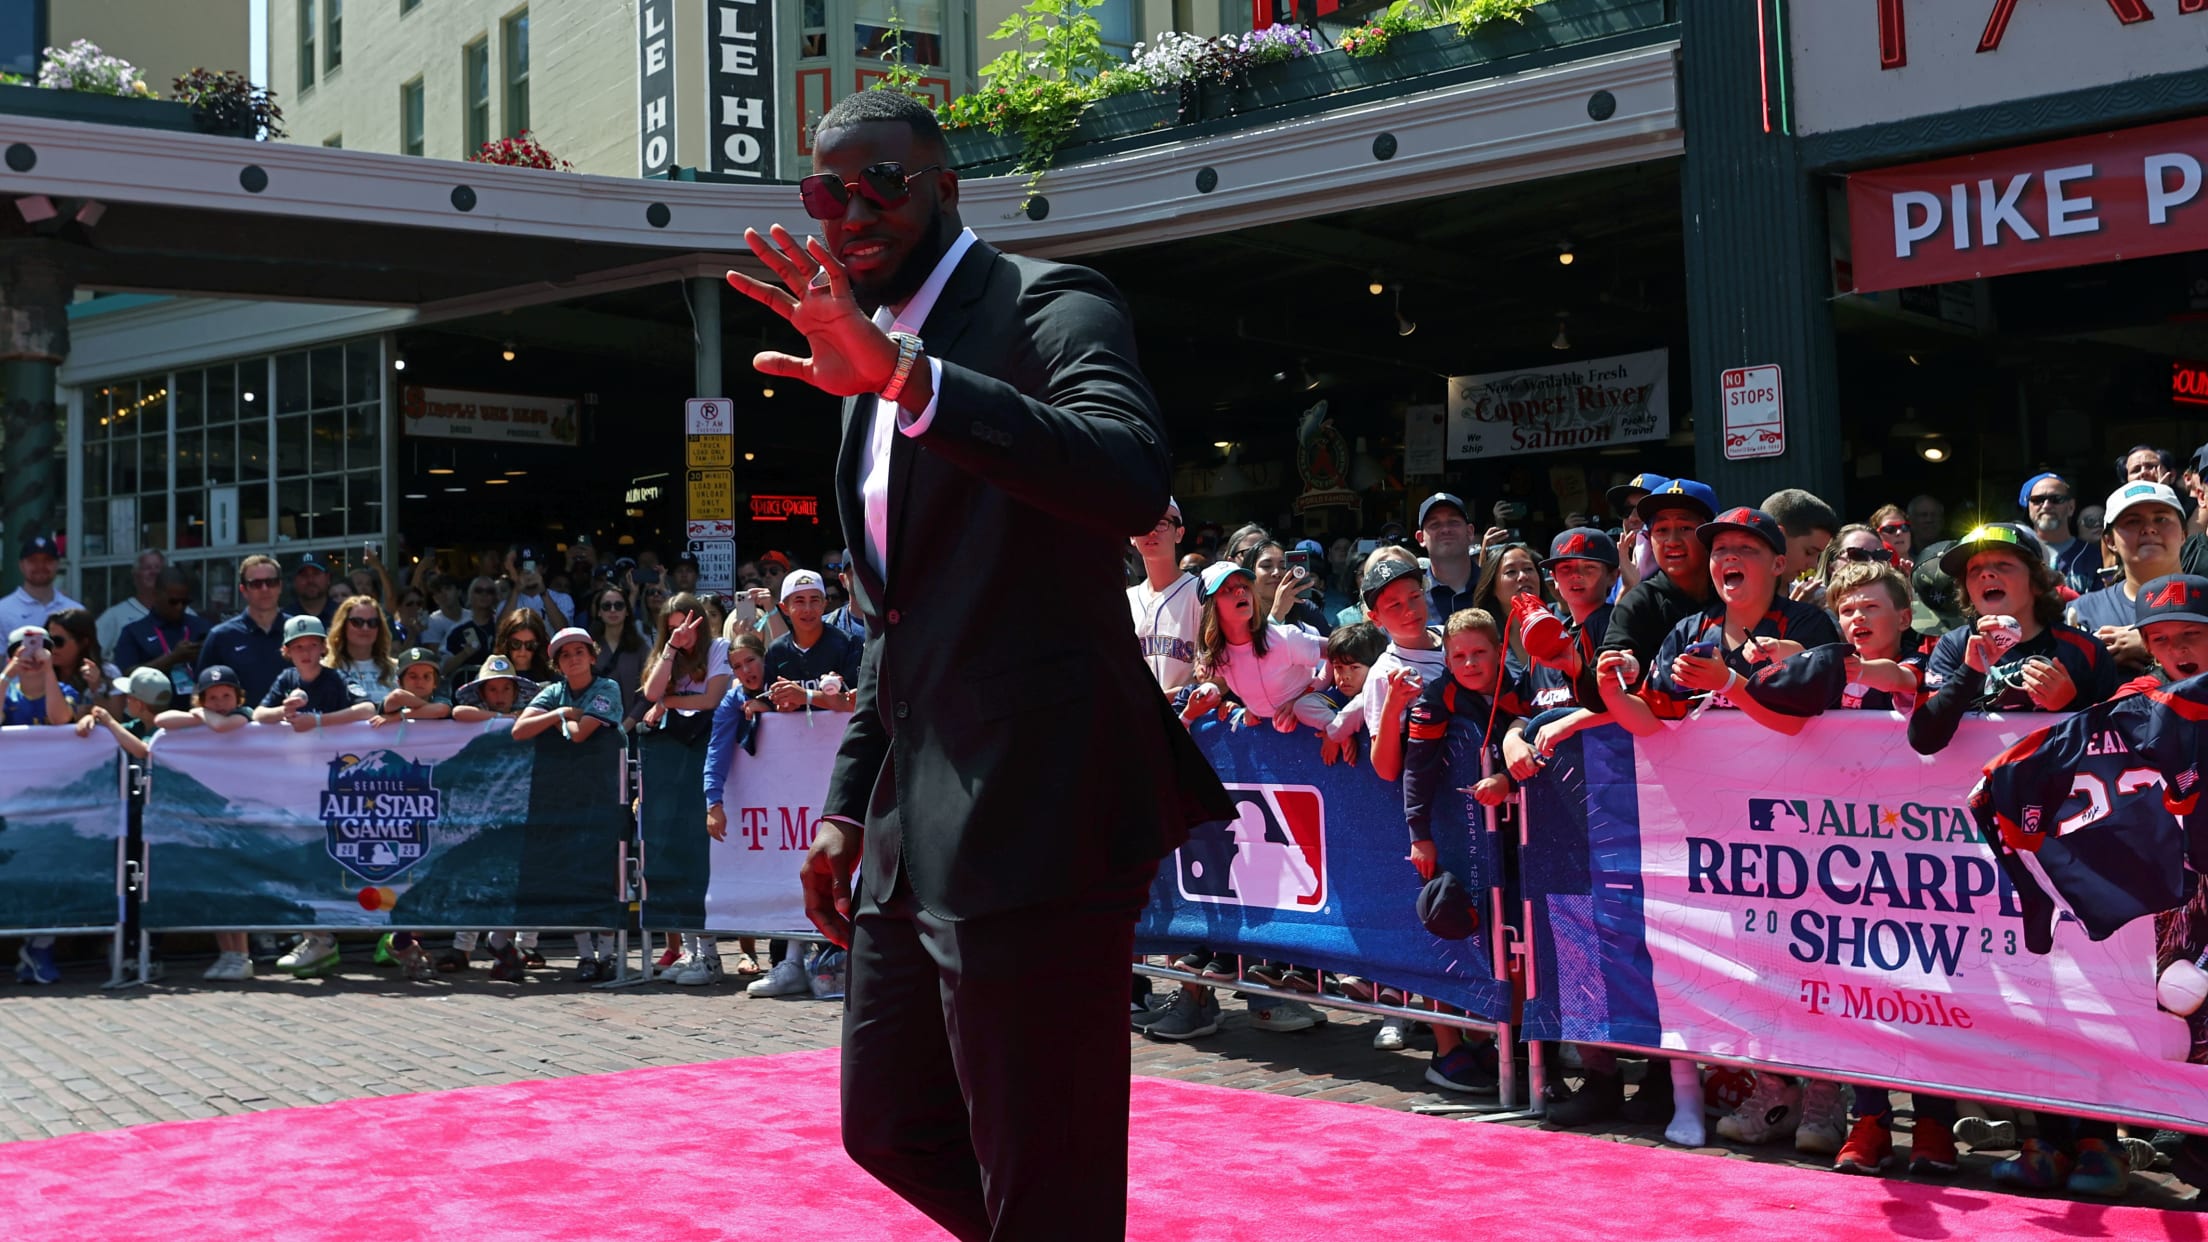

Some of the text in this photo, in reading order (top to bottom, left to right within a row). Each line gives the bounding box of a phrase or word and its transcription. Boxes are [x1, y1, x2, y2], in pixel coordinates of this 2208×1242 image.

[645, 0, 669, 177] LE HO
[719, 0, 765, 178] LE HO
[1892, 163, 2100, 258] PIKE
[1588, 364, 1628, 384] Fresh
[1726, 374, 1742, 386] NO
[1475, 383, 1653, 427] Copper River
[1731, 387, 1775, 406] STOPS
[713, 420, 724, 428] AM
[1466, 433, 1482, 443] We
[1510, 423, 1612, 451] Salmon
[1461, 443, 1484, 454] Ship
[690, 472, 702, 481] 30
[694, 542, 730, 551] 3 MINUTE
[697, 553, 731, 562] ASSENGER
[713, 563, 731, 572] ONLY
[354, 780, 404, 791] SEATTLE
[322, 793, 436, 818] ALL STAR
[340, 817, 414, 839] GAME
[1817, 799, 1893, 839] ALL
[341, 844, 416, 857] 20 23
[1685, 837, 2025, 918] RED CARPE
[1788, 909, 1969, 977] SHOW
[1838, 984, 1974, 1029] Mobile
